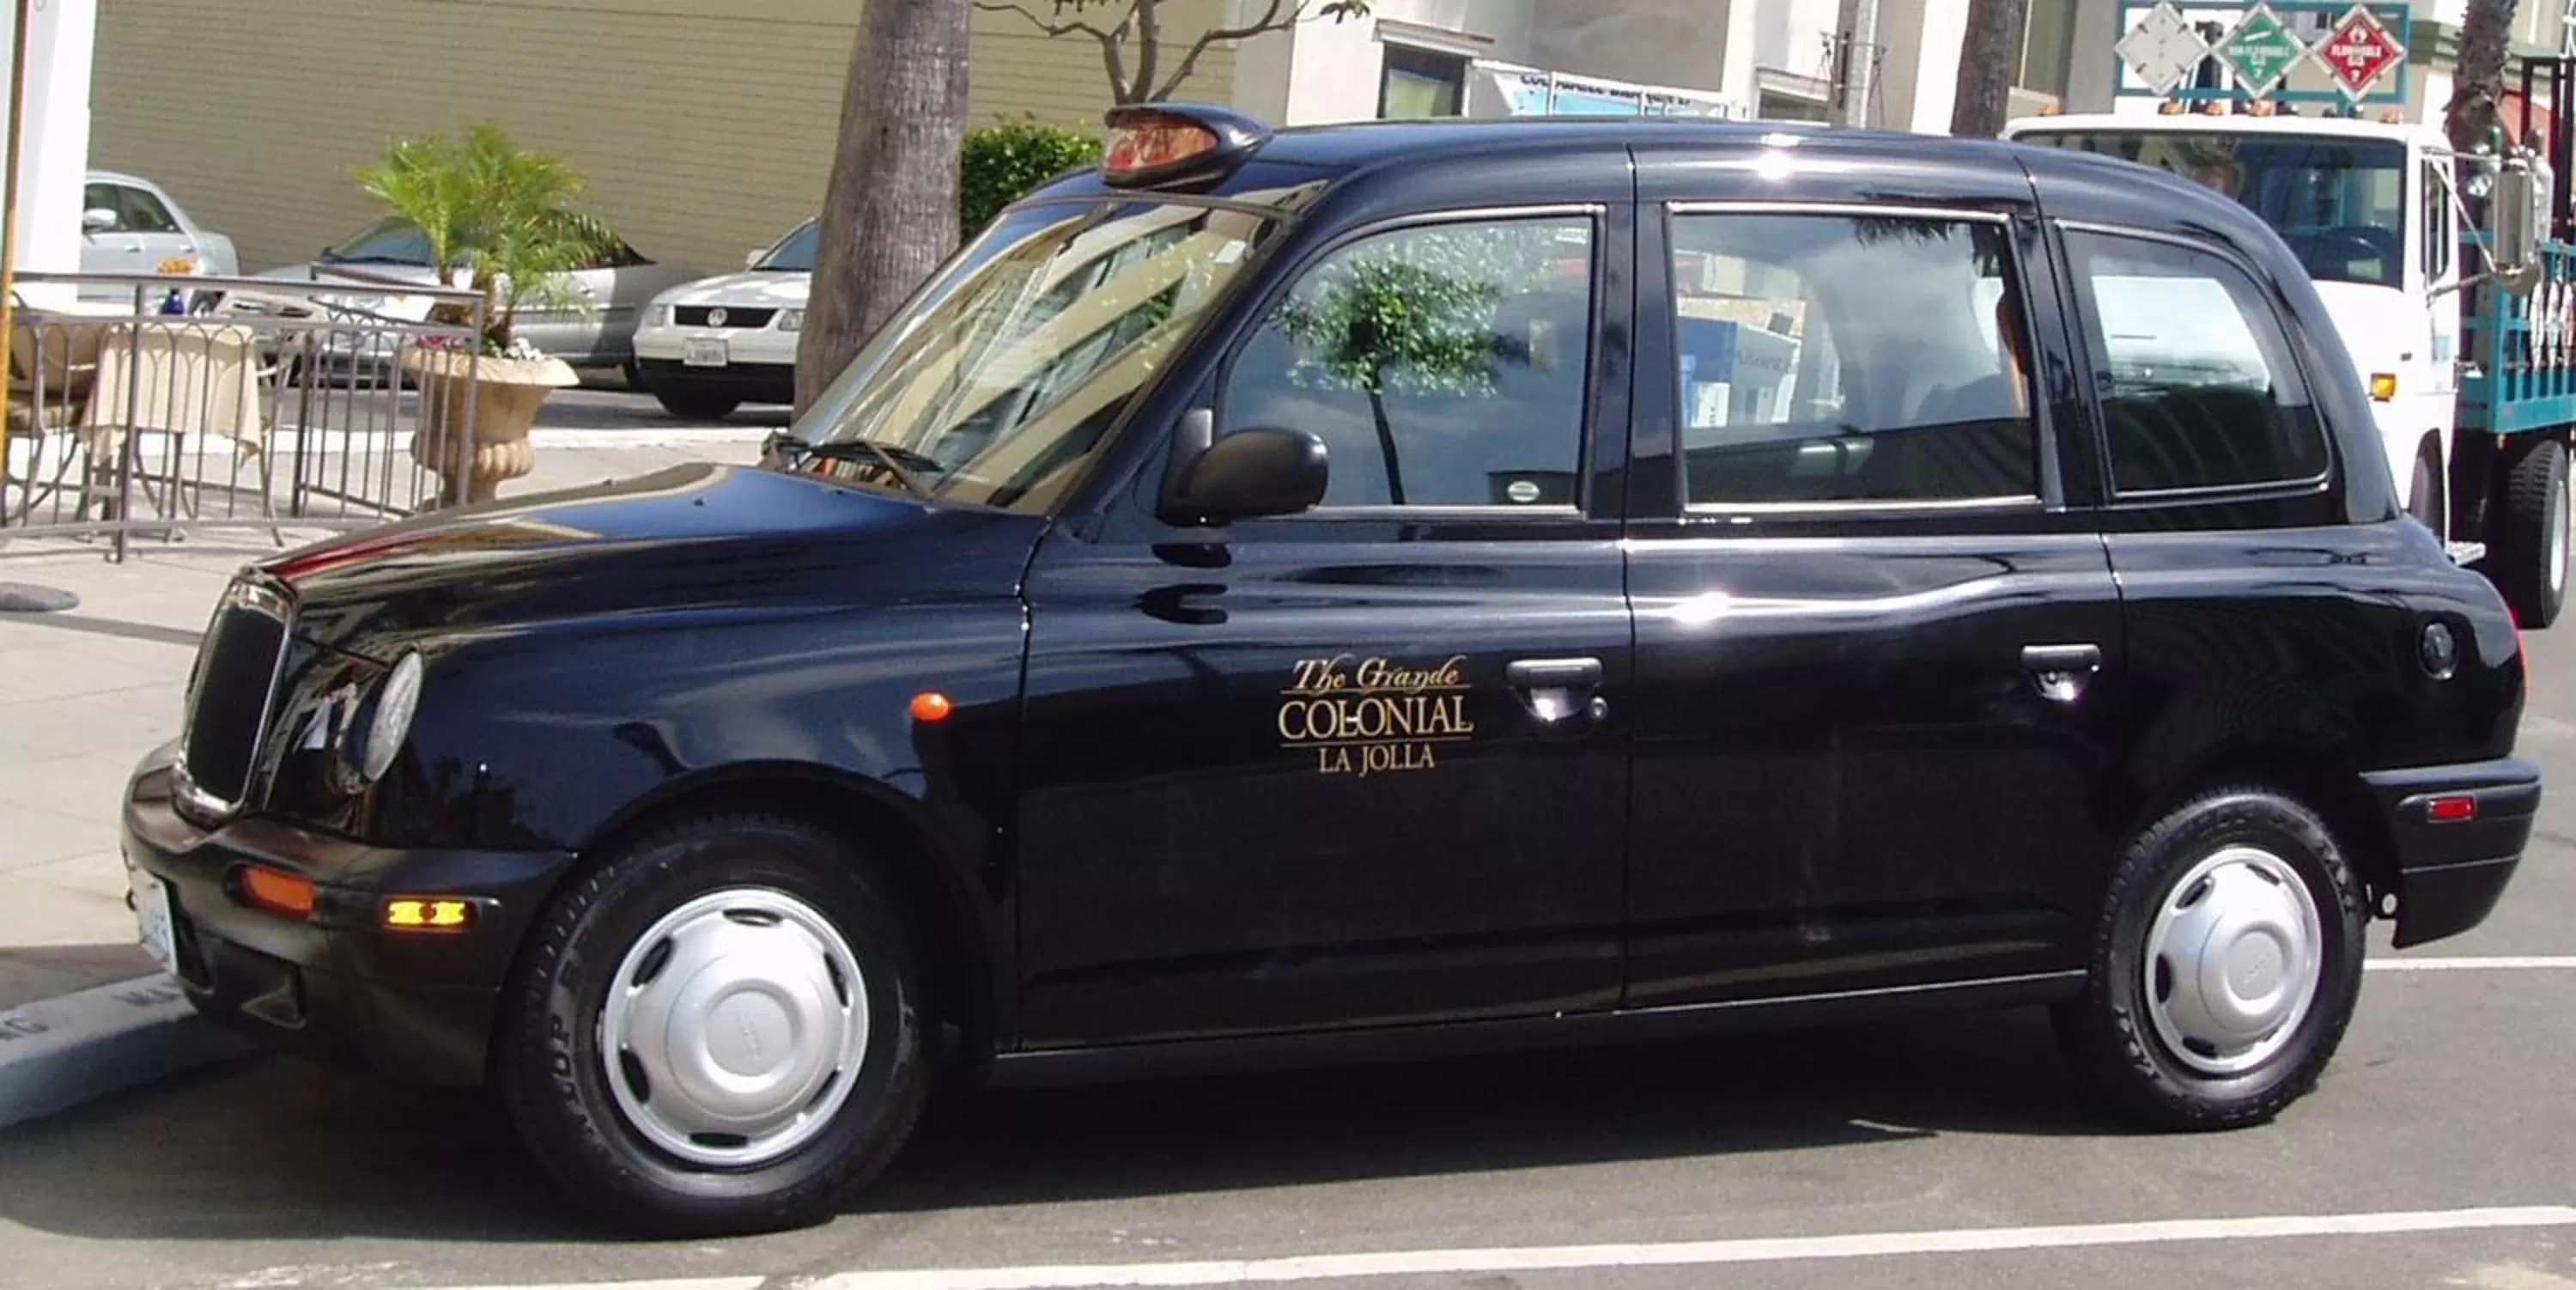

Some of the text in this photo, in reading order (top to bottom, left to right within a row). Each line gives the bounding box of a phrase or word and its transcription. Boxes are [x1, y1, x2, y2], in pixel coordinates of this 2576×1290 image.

[1293, 653, 1467, 697] The Grande
[1278, 697, 1474, 739] COLONIAL
[1319, 744, 1436, 777] LA JOLLA
